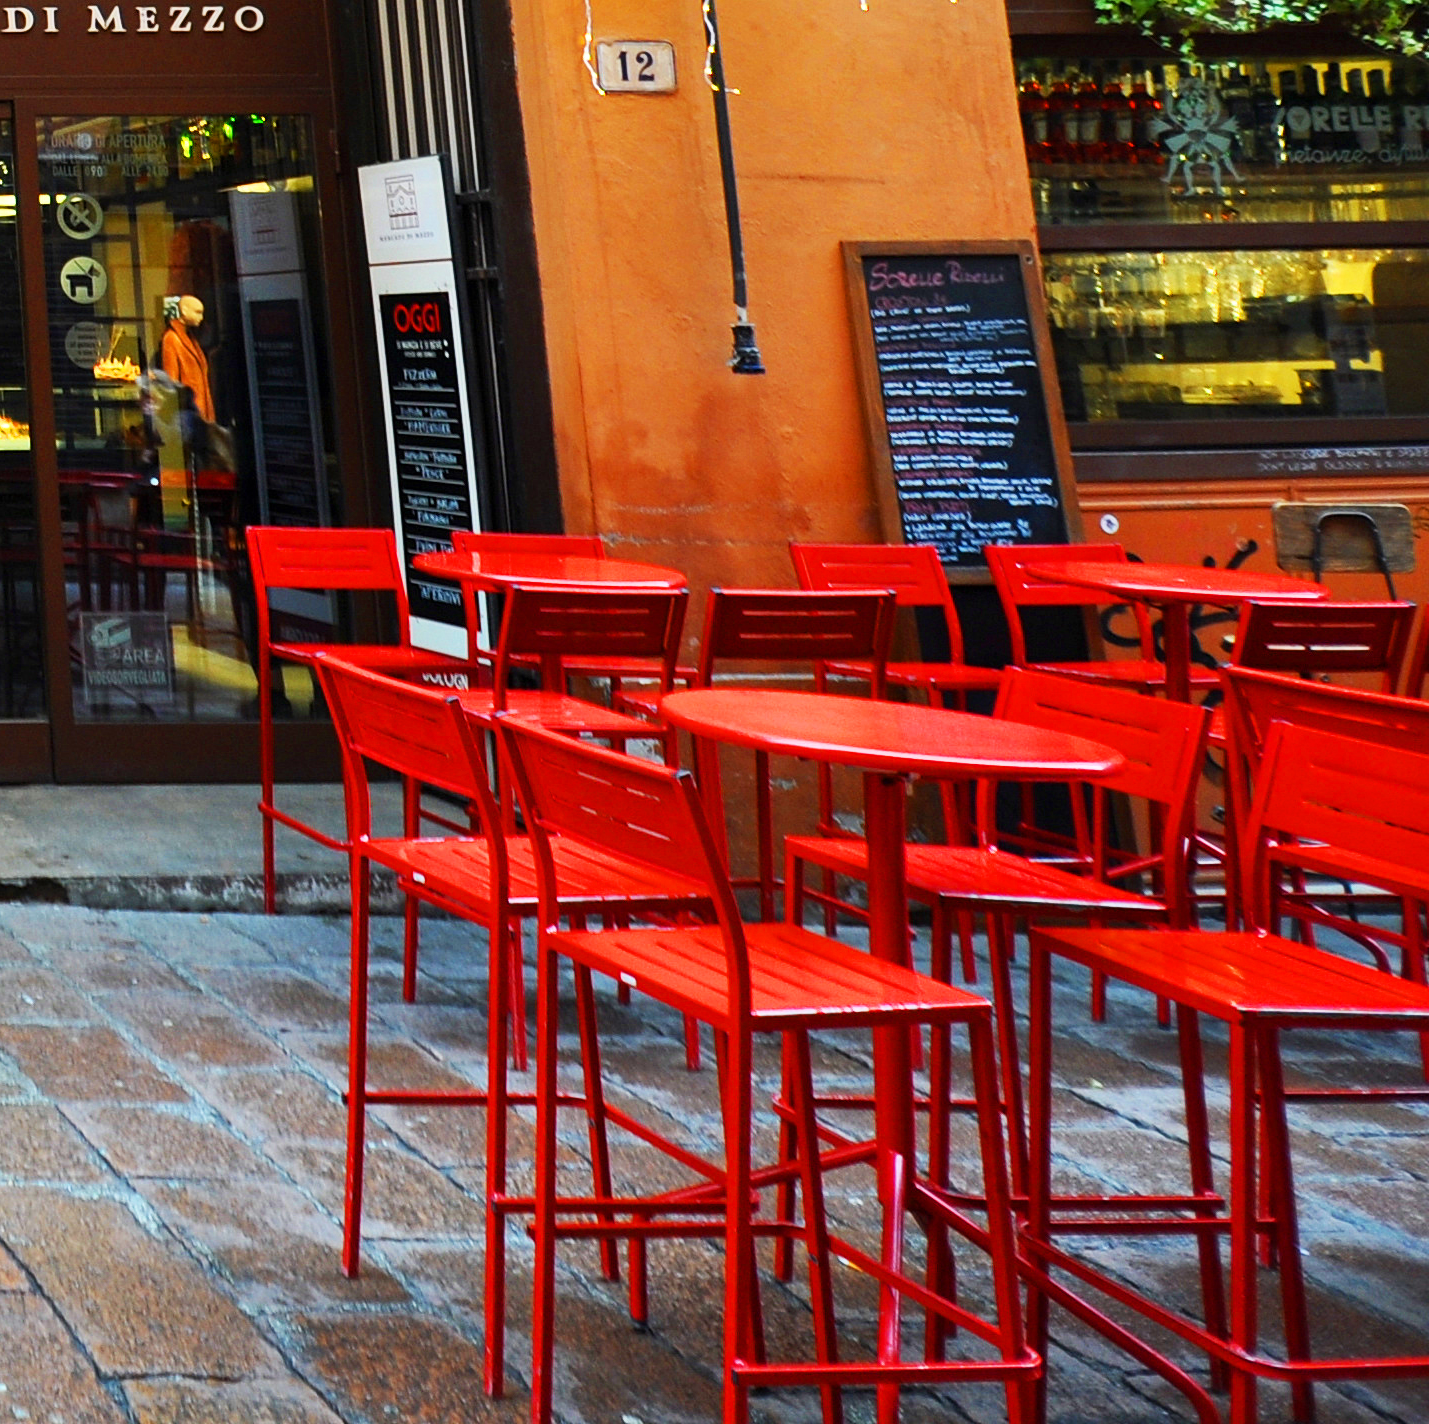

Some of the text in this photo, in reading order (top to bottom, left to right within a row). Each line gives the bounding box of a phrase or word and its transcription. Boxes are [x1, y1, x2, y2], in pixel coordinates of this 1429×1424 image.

[1, 5, 59, 34] DI
[87, 4, 266, 33] MEZZO
[617, 50, 656, 82] 12
[107, 133, 166, 149] APERTURA
[393, 302, 442, 334] OGGI
[122, 648, 166, 664] AREA
